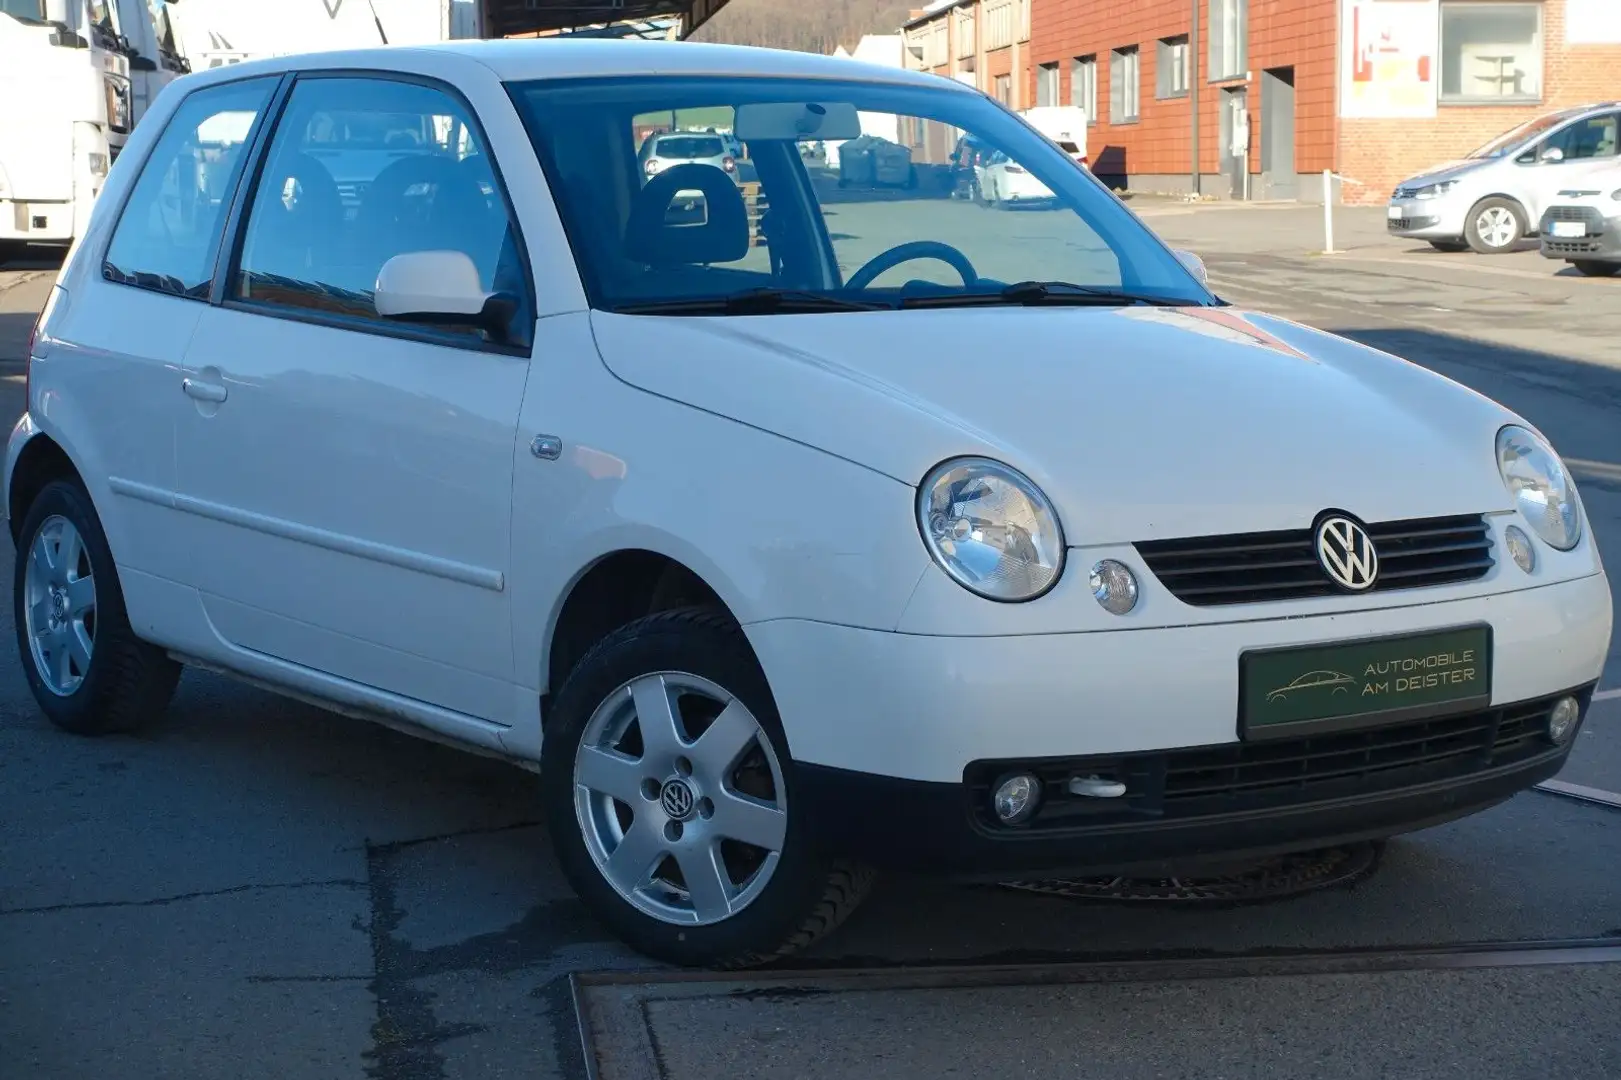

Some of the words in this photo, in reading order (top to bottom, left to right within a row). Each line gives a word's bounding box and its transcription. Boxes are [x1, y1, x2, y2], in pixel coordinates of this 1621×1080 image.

[1318, 518, 1377, 589] VW
[1363, 649, 1475, 676] AUTOMOBILE
[1361, 681, 1389, 697] AM
[1396, 667, 1475, 692] DEISTER
